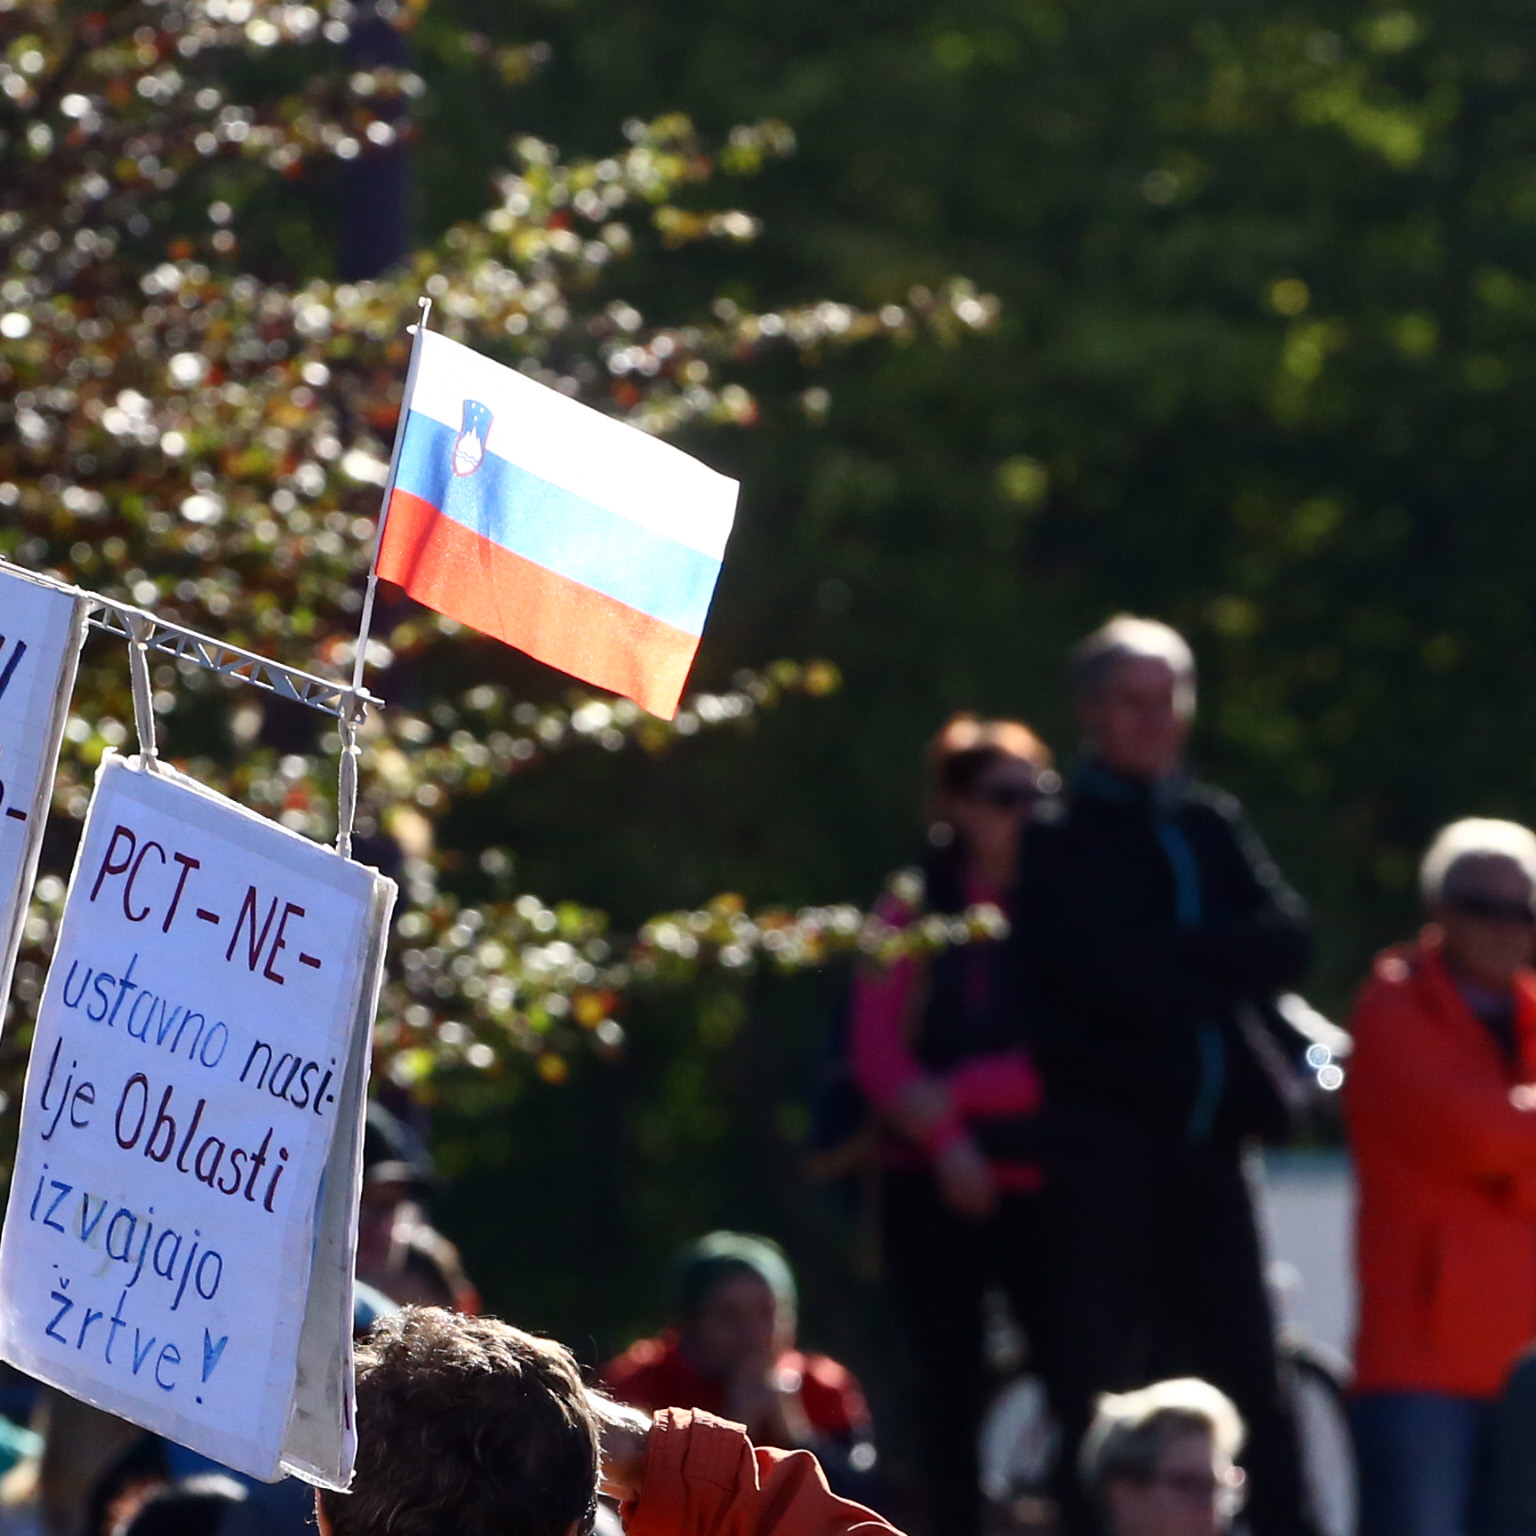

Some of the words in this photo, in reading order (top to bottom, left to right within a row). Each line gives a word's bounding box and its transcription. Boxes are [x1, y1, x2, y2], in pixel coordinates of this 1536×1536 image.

[63, 954, 228, 1069] ustavno
[40, 1036, 96, 1140] lje
[115, 1072, 289, 1213] Oblasti
[30, 1164, 222, 1310] izvajajo
